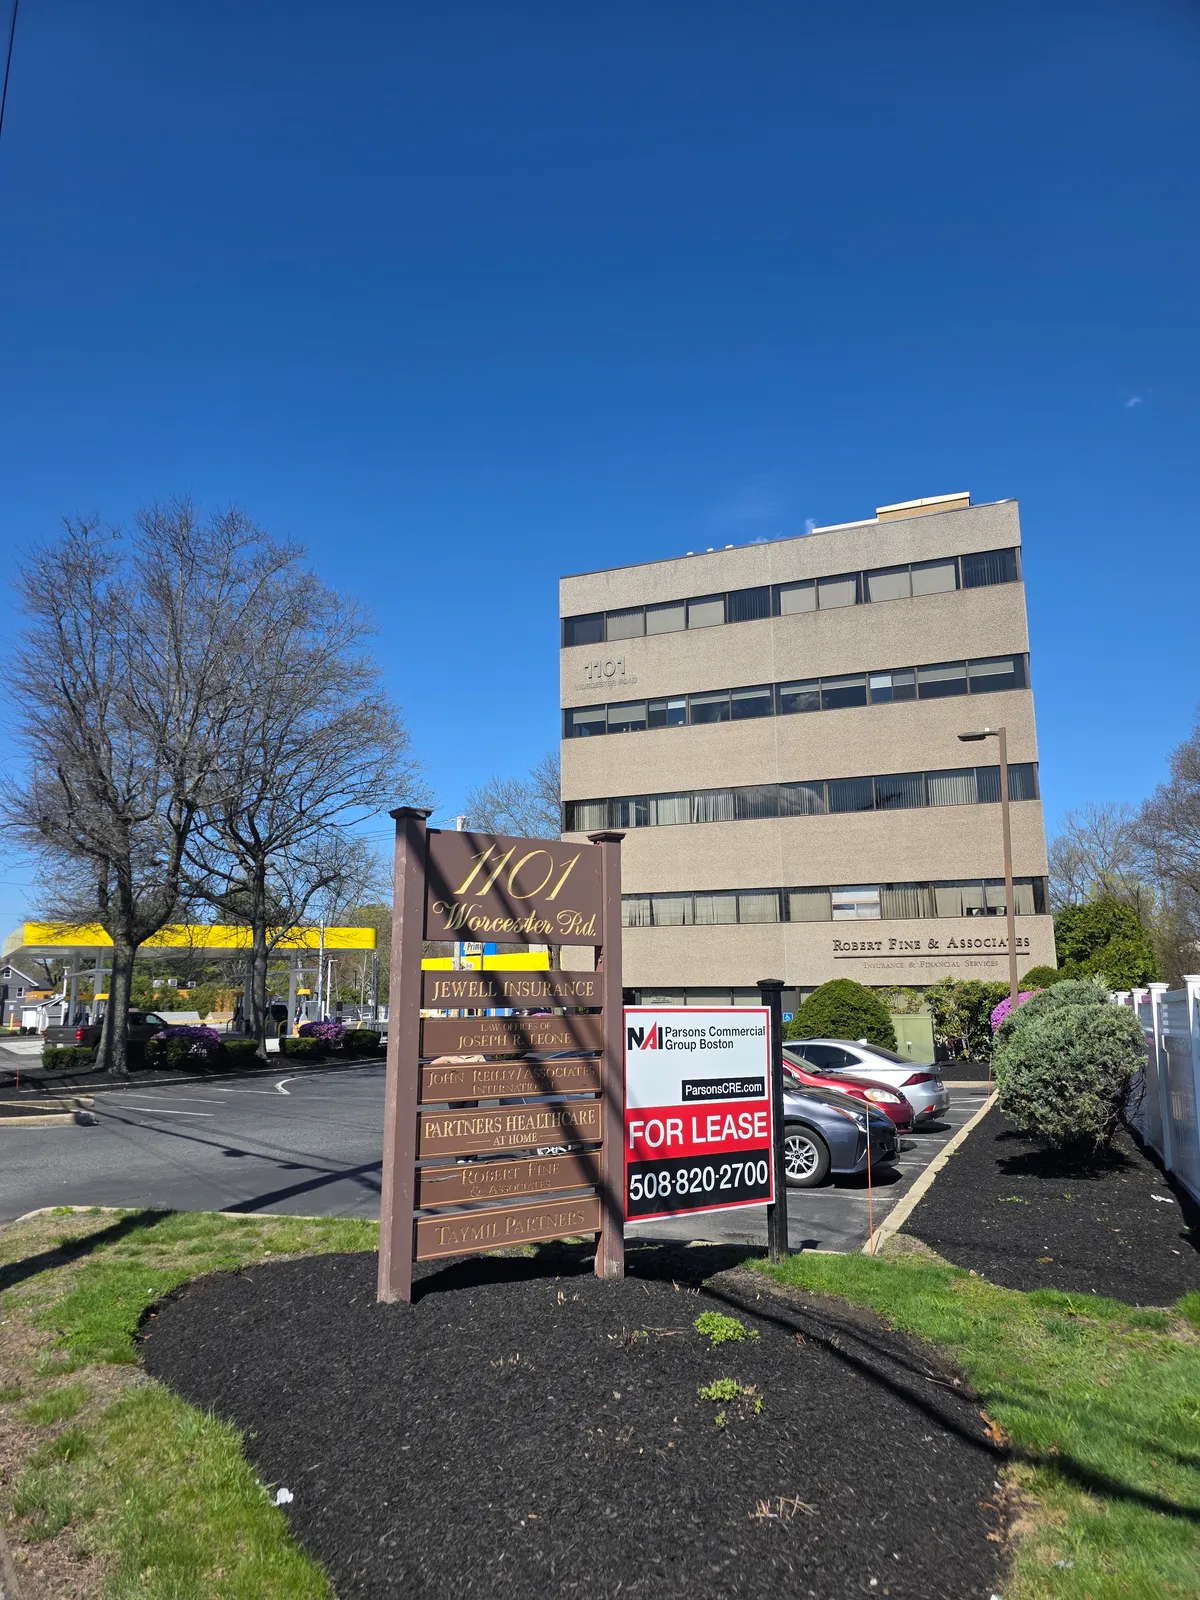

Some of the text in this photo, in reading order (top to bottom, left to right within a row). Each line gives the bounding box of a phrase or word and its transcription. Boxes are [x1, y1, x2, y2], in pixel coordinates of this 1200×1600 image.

[585, 653, 626, 680] 1101
[453, 844, 581, 901] 1101
[432, 901, 597, 937] Worcester Rd.
[833, 936, 1030, 951] ROBERT FINE & ASSOCIAES
[863, 961, 904, 969] INSURANCE
[919, 960, 960, 968] FINANCIAL
[964, 959, 999, 967] SERVICES
[432, 981, 594, 1001] JEWELL INSURANCE
[480, 1022, 551, 1032] LAW OFFICES OF
[627, 1021, 663, 1050] NAI
[665, 1025, 766, 1037] Parsons Commercial
[457, 1032, 571, 1050] JOSEPH R. LEONE
[665, 1039, 734, 1052] Group Boston
[427, 1071, 464, 1088] JOHN
[685, 1082, 762, 1096] ParsonsCRE.com
[424, 1109, 596, 1139] PARTNERS HEALTHCARE
[629, 1111, 768, 1149] FOR LEASE
[493, 1133, 538, 1146] AT HOME
[461, 1162, 560, 1185] ROBERT FINE
[629, 1160, 768, 1201] 508-820-2700
[470, 1179, 551, 1197] & ASSOCIATES
[434, 1210, 585, 1246] TAYMIL PARTNERS
